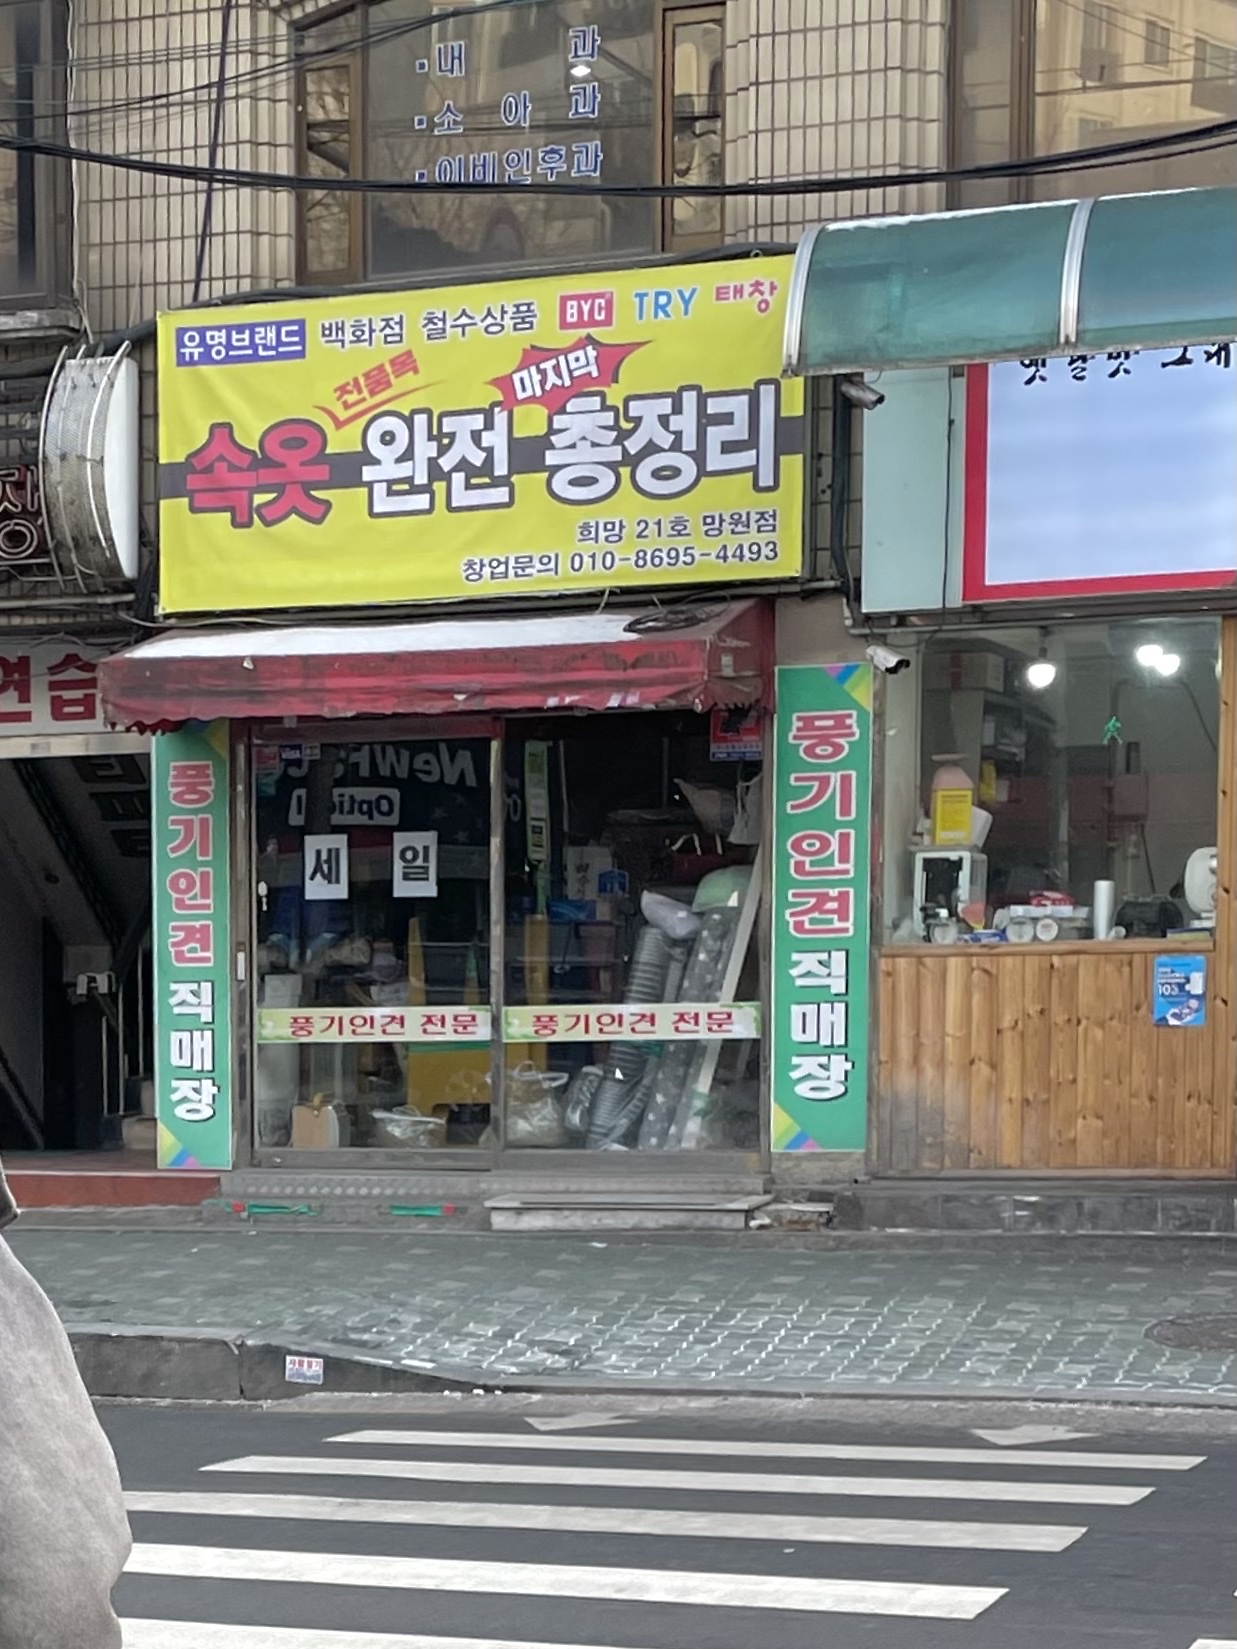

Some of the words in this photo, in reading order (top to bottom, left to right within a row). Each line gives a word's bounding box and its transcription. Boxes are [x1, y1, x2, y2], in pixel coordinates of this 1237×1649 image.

[435, 141, 604, 184] 이비인후과
[179, 324, 304, 362] 유명브랜드
[320, 314, 406, 349] 백화점
[421, 302, 539, 342] 철수상품
[565, 296, 607, 324] BYC
[634, 286, 698, 319] TRY
[714, 279, 778, 314] 태창
[332, 350, 421, 411] 전품목
[511, 345, 599, 402] 마지막
[186, 418, 332, 526] 속옷
[362, 404, 512, 517] 완전
[544, 378, 781, 504] 총정리
[577, 519, 626, 544] 희망
[636, 513, 691, 540] 21호
[701, 510, 779, 538] 망원점
[462, 553, 561, 581] 창업문의
[570, 541, 780, 574] 010-8695-4493
[786, 710, 860, 940] 풍기인견
[166, 760, 215, 968] 풍기인견
[167, 980, 220, 1123] 직매장
[288, 1012, 407, 1039] 풍기인견
[420, 1011, 480, 1038] 전문
[530, 1012, 656, 1037] 풍기인견
[672, 1009, 735, 1035] 전문
[787, 949, 853, 1103] 직매장
